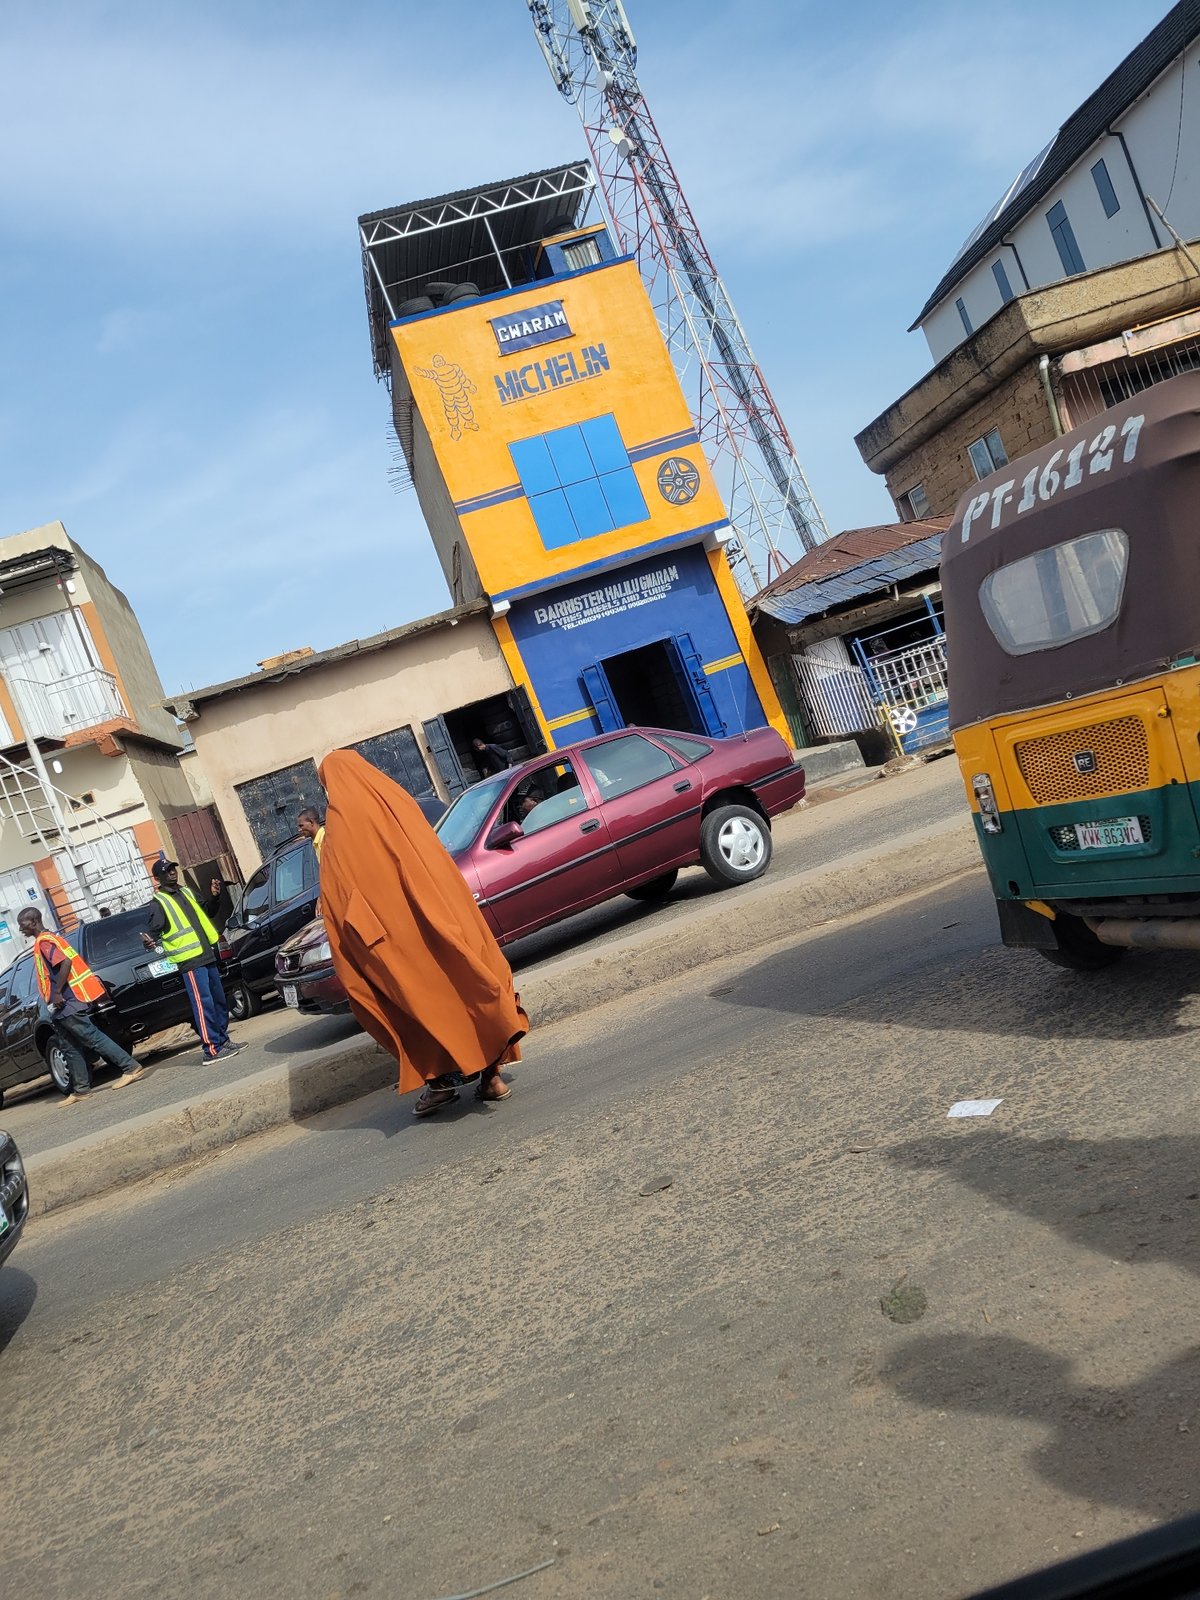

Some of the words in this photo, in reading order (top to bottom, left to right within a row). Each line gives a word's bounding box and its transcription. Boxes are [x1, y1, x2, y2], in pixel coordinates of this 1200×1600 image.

[497, 310, 566, 343] GWARAM
[493, 342, 611, 404] MICHELIN
[961, 414, 1145, 543] PT-16127
[534, 588, 606, 624] BARRISTER
[549, 612, 583, 628] TYRES
[584, 599, 620, 619] WHEELS
[620, 593, 640, 607] AND
[641, 583, 672, 600] TUBES
